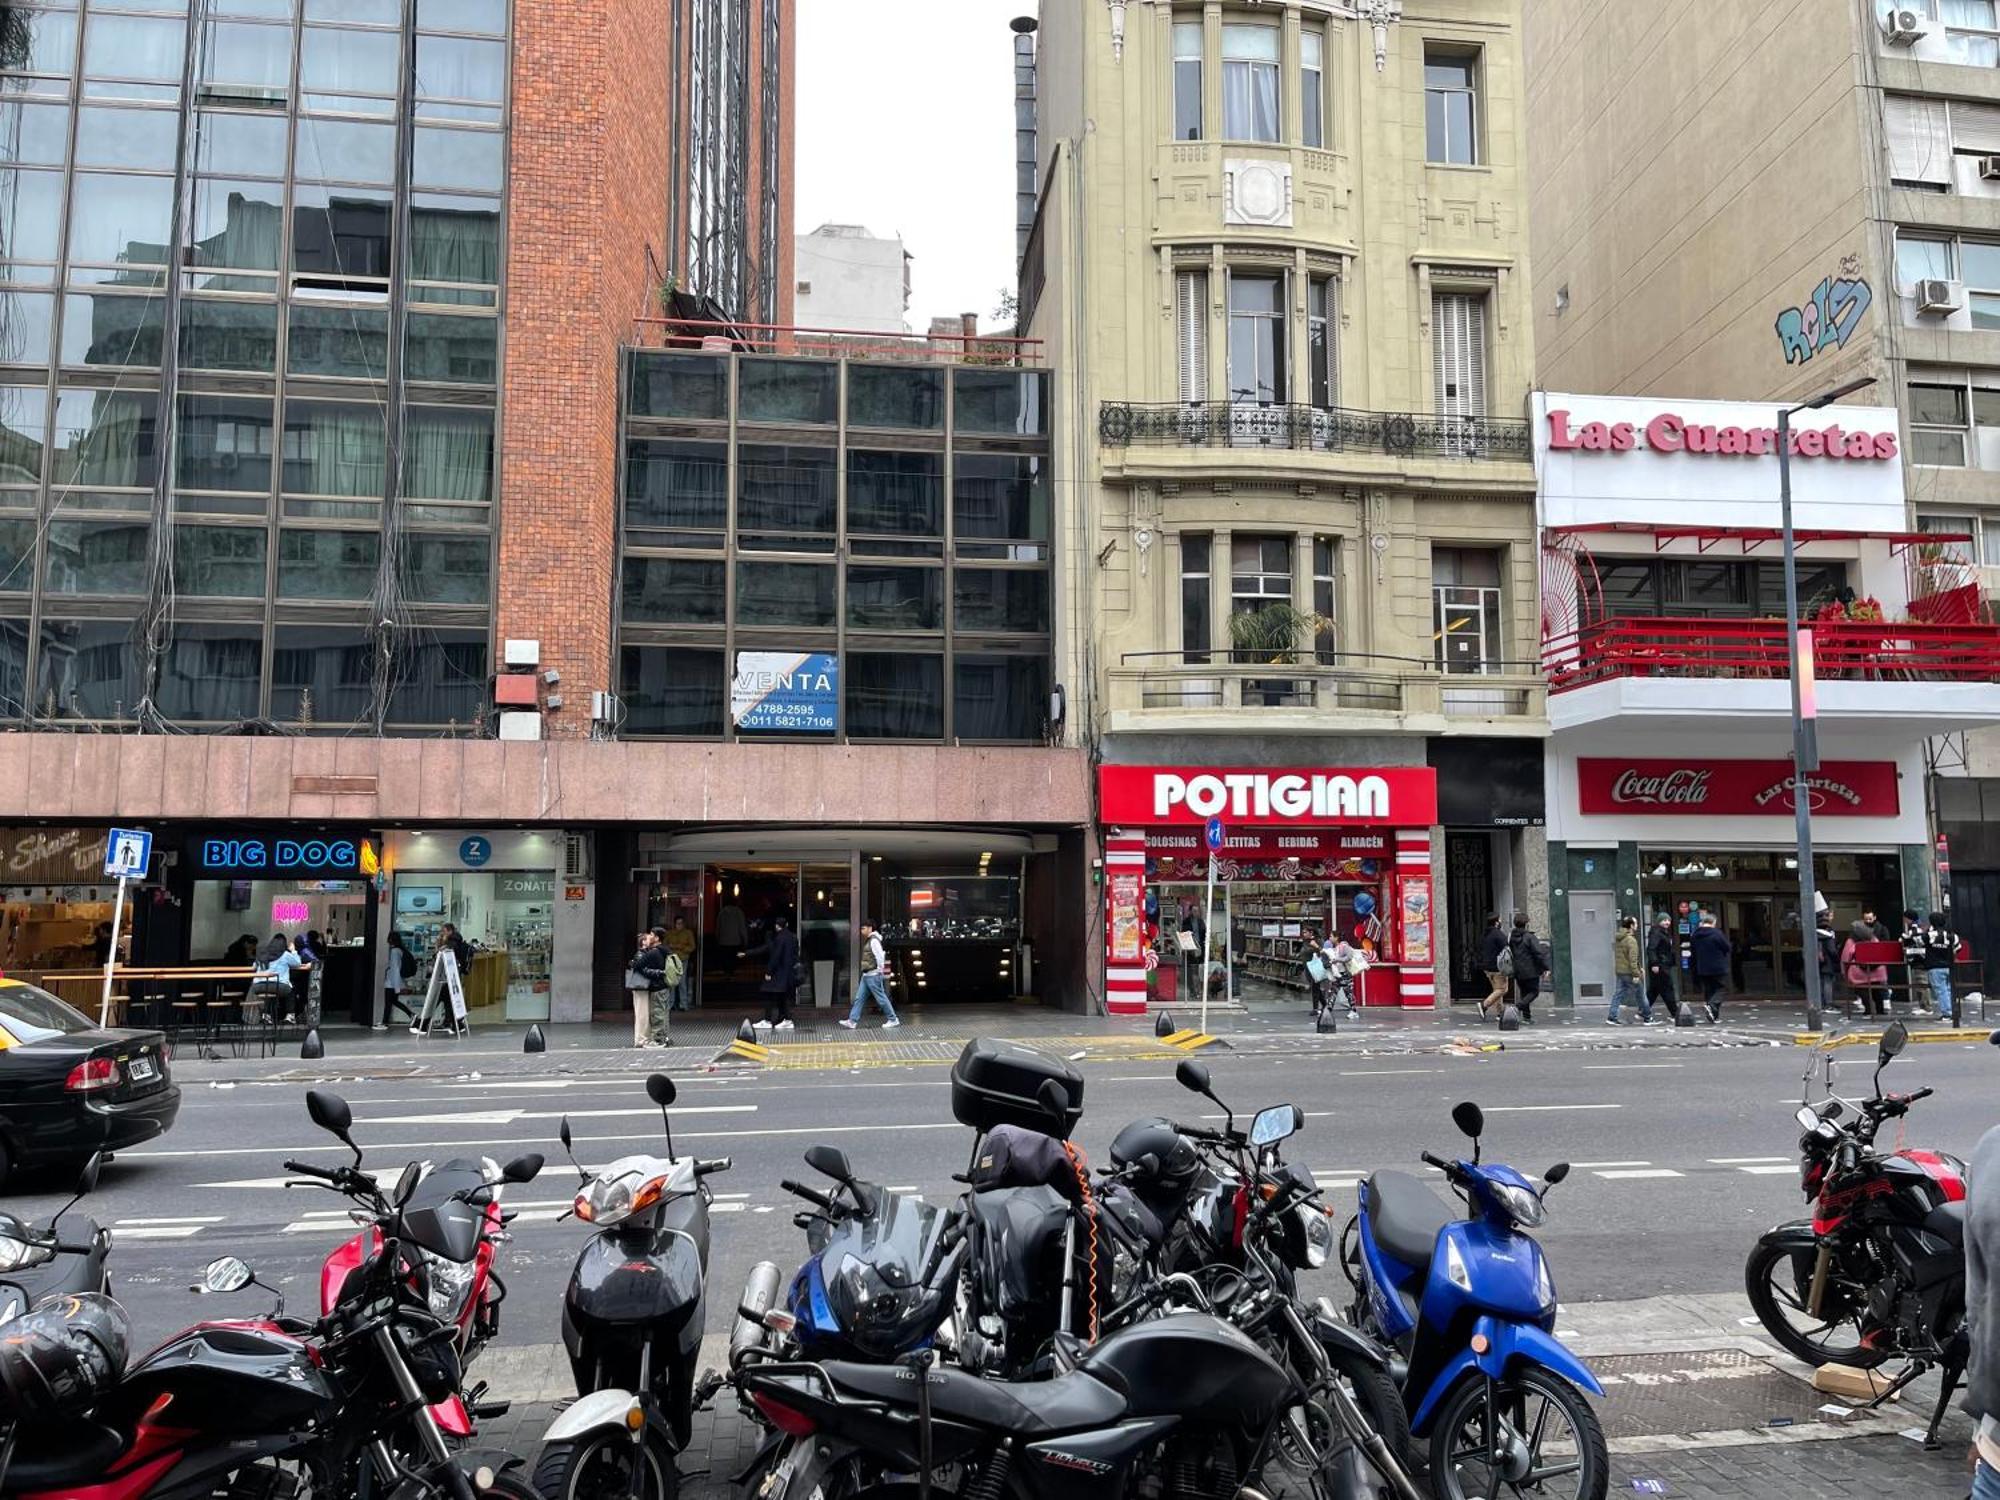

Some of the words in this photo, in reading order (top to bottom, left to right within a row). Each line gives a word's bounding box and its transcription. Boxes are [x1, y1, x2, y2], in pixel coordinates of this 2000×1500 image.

[1548, 410, 1635, 451] Las
[737, 672, 832, 691] VENTA
[755, 704, 814, 715] 4788-2595
[751, 716, 772, 726] 011
[775, 716, 833, 727] 5821-7106
[1612, 769, 1713, 804] Coca-Cola
[1755, 783, 1783, 806] Las
[1783, 777, 1862, 805] Cartetas
[1153, 774, 1390, 817] POTIGIAN
[1145, 836, 1198, 848] GOLOSINAS
[1222, 837, 1262, 848] LETITAS
[1278, 836, 1319, 848] BEBIDAS
[1341, 834, 1384, 848] ALMACÉN
[204, 840, 266, 867] BIG
[276, 840, 356, 867] DOG
[469, 842, 481, 855] Z
[895, 1370, 946, 1384] HODA
